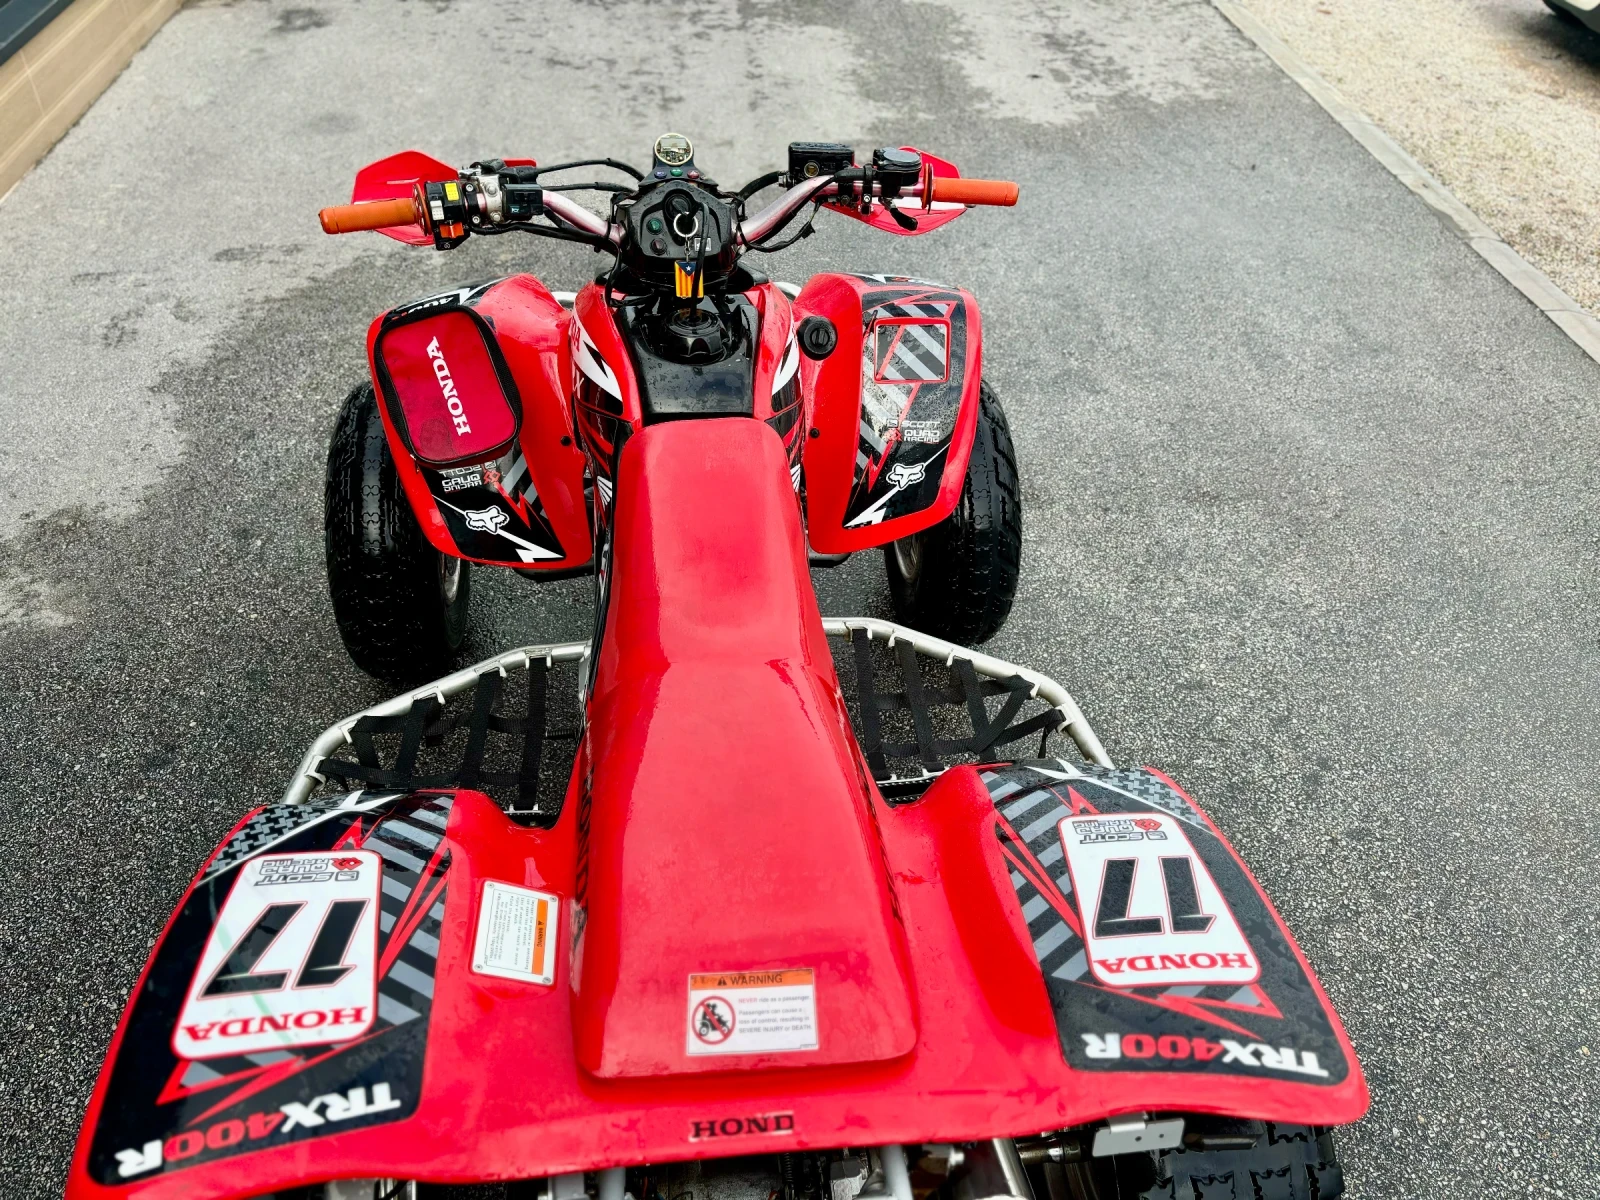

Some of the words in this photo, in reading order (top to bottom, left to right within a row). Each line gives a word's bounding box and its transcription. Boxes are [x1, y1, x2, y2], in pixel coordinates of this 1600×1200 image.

[426, 335, 472, 436] HONDA
[901, 420, 941, 428] SCOTT
[904, 429, 940, 437] QUAD
[1075, 825, 1134, 835] QUAD
[1080, 832, 1144, 844] SCOTT
[253, 871, 335, 886] SCOTT
[259, 864, 329, 875] QUAD
[1092, 855, 1217, 940] 17
[537, 928, 545, 948] WARNING
[196, 898, 372, 1002] 17
[1094, 952, 1253, 974] HONDA
[730, 973, 783, 986] WARNING
[182, 1006, 368, 1042] HONDA
[1081, 1033, 1329, 1077] TRX400R
[114, 1082, 401, 1178] TRX400R
